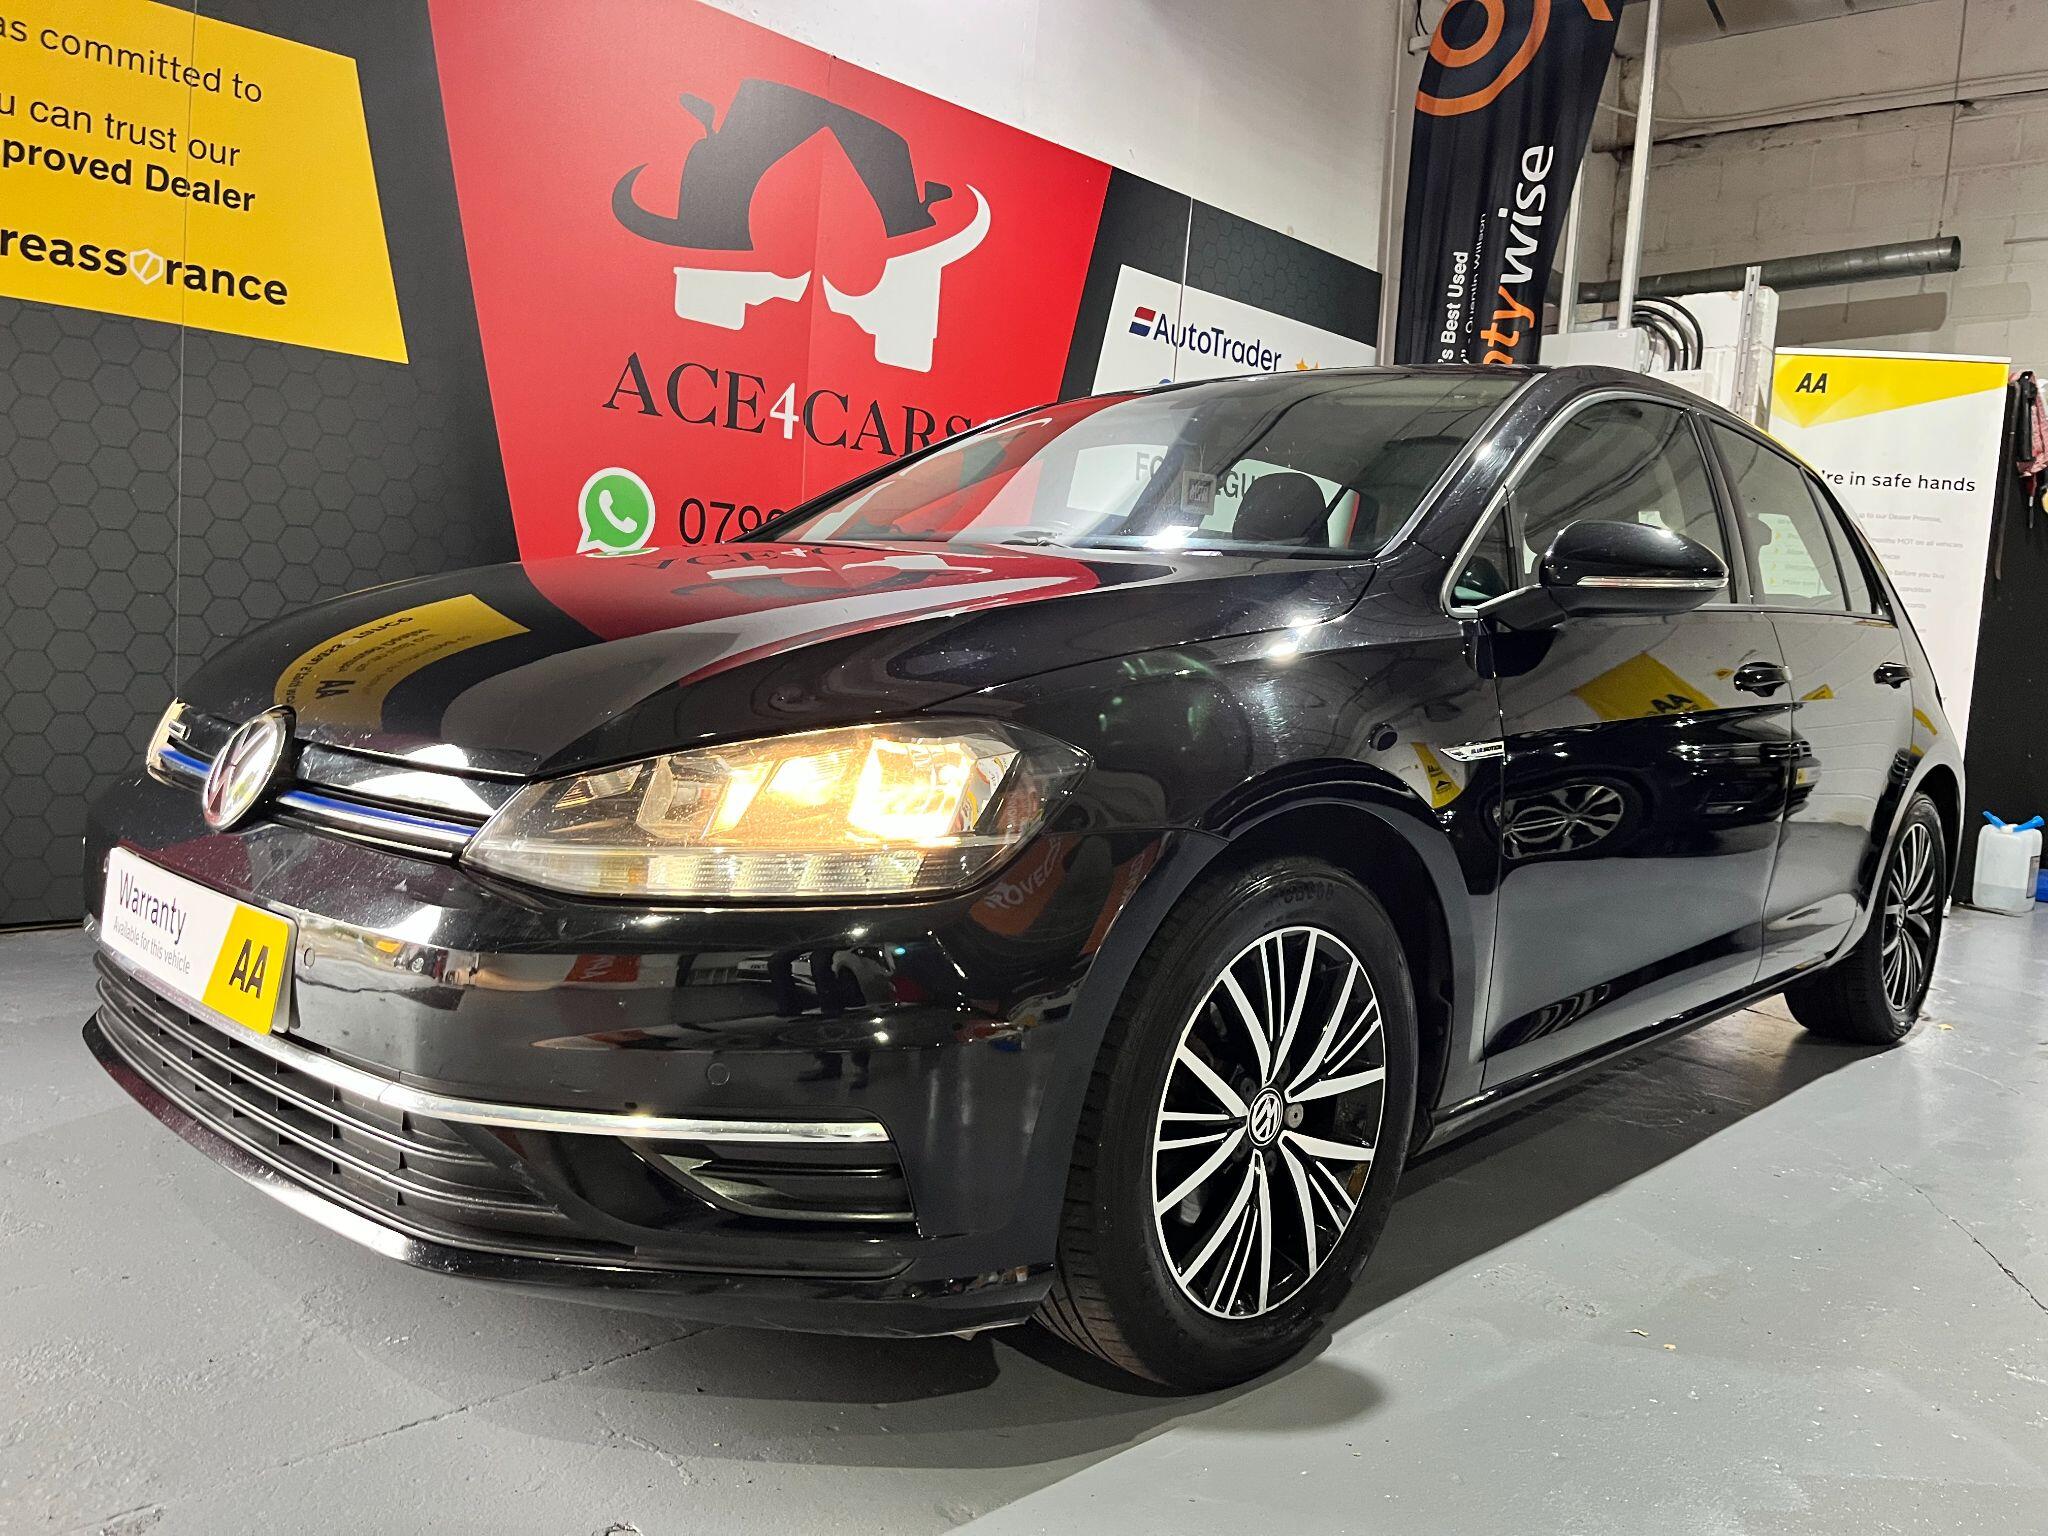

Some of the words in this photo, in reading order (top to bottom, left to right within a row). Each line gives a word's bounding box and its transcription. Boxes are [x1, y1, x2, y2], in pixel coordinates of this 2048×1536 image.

[40, 29, 222, 94] committed
[232, 72, 262, 103] to
[29, 101, 92, 134] can
[105, 113, 177, 154] trust
[188, 138, 241, 167] our
[146, 164, 256, 213] Dealer
[1446, 251, 1469, 298] Used
[1153, 313, 1282, 372] AutoTrader
[1440, 302, 1462, 344] Best
[1795, 373, 1828, 394] AA
[1850, 471, 1866, 487] in
[1872, 472, 1912, 489] safe
[1918, 475, 1976, 492] hands
[119, 868, 187, 945] Warranty
[113, 916, 140, 946] Available
[140, 931, 151, 952] for
[150, 938, 163, 960] this
[164, 948, 191, 975] vehicle
[229, 938, 270, 999] AA
